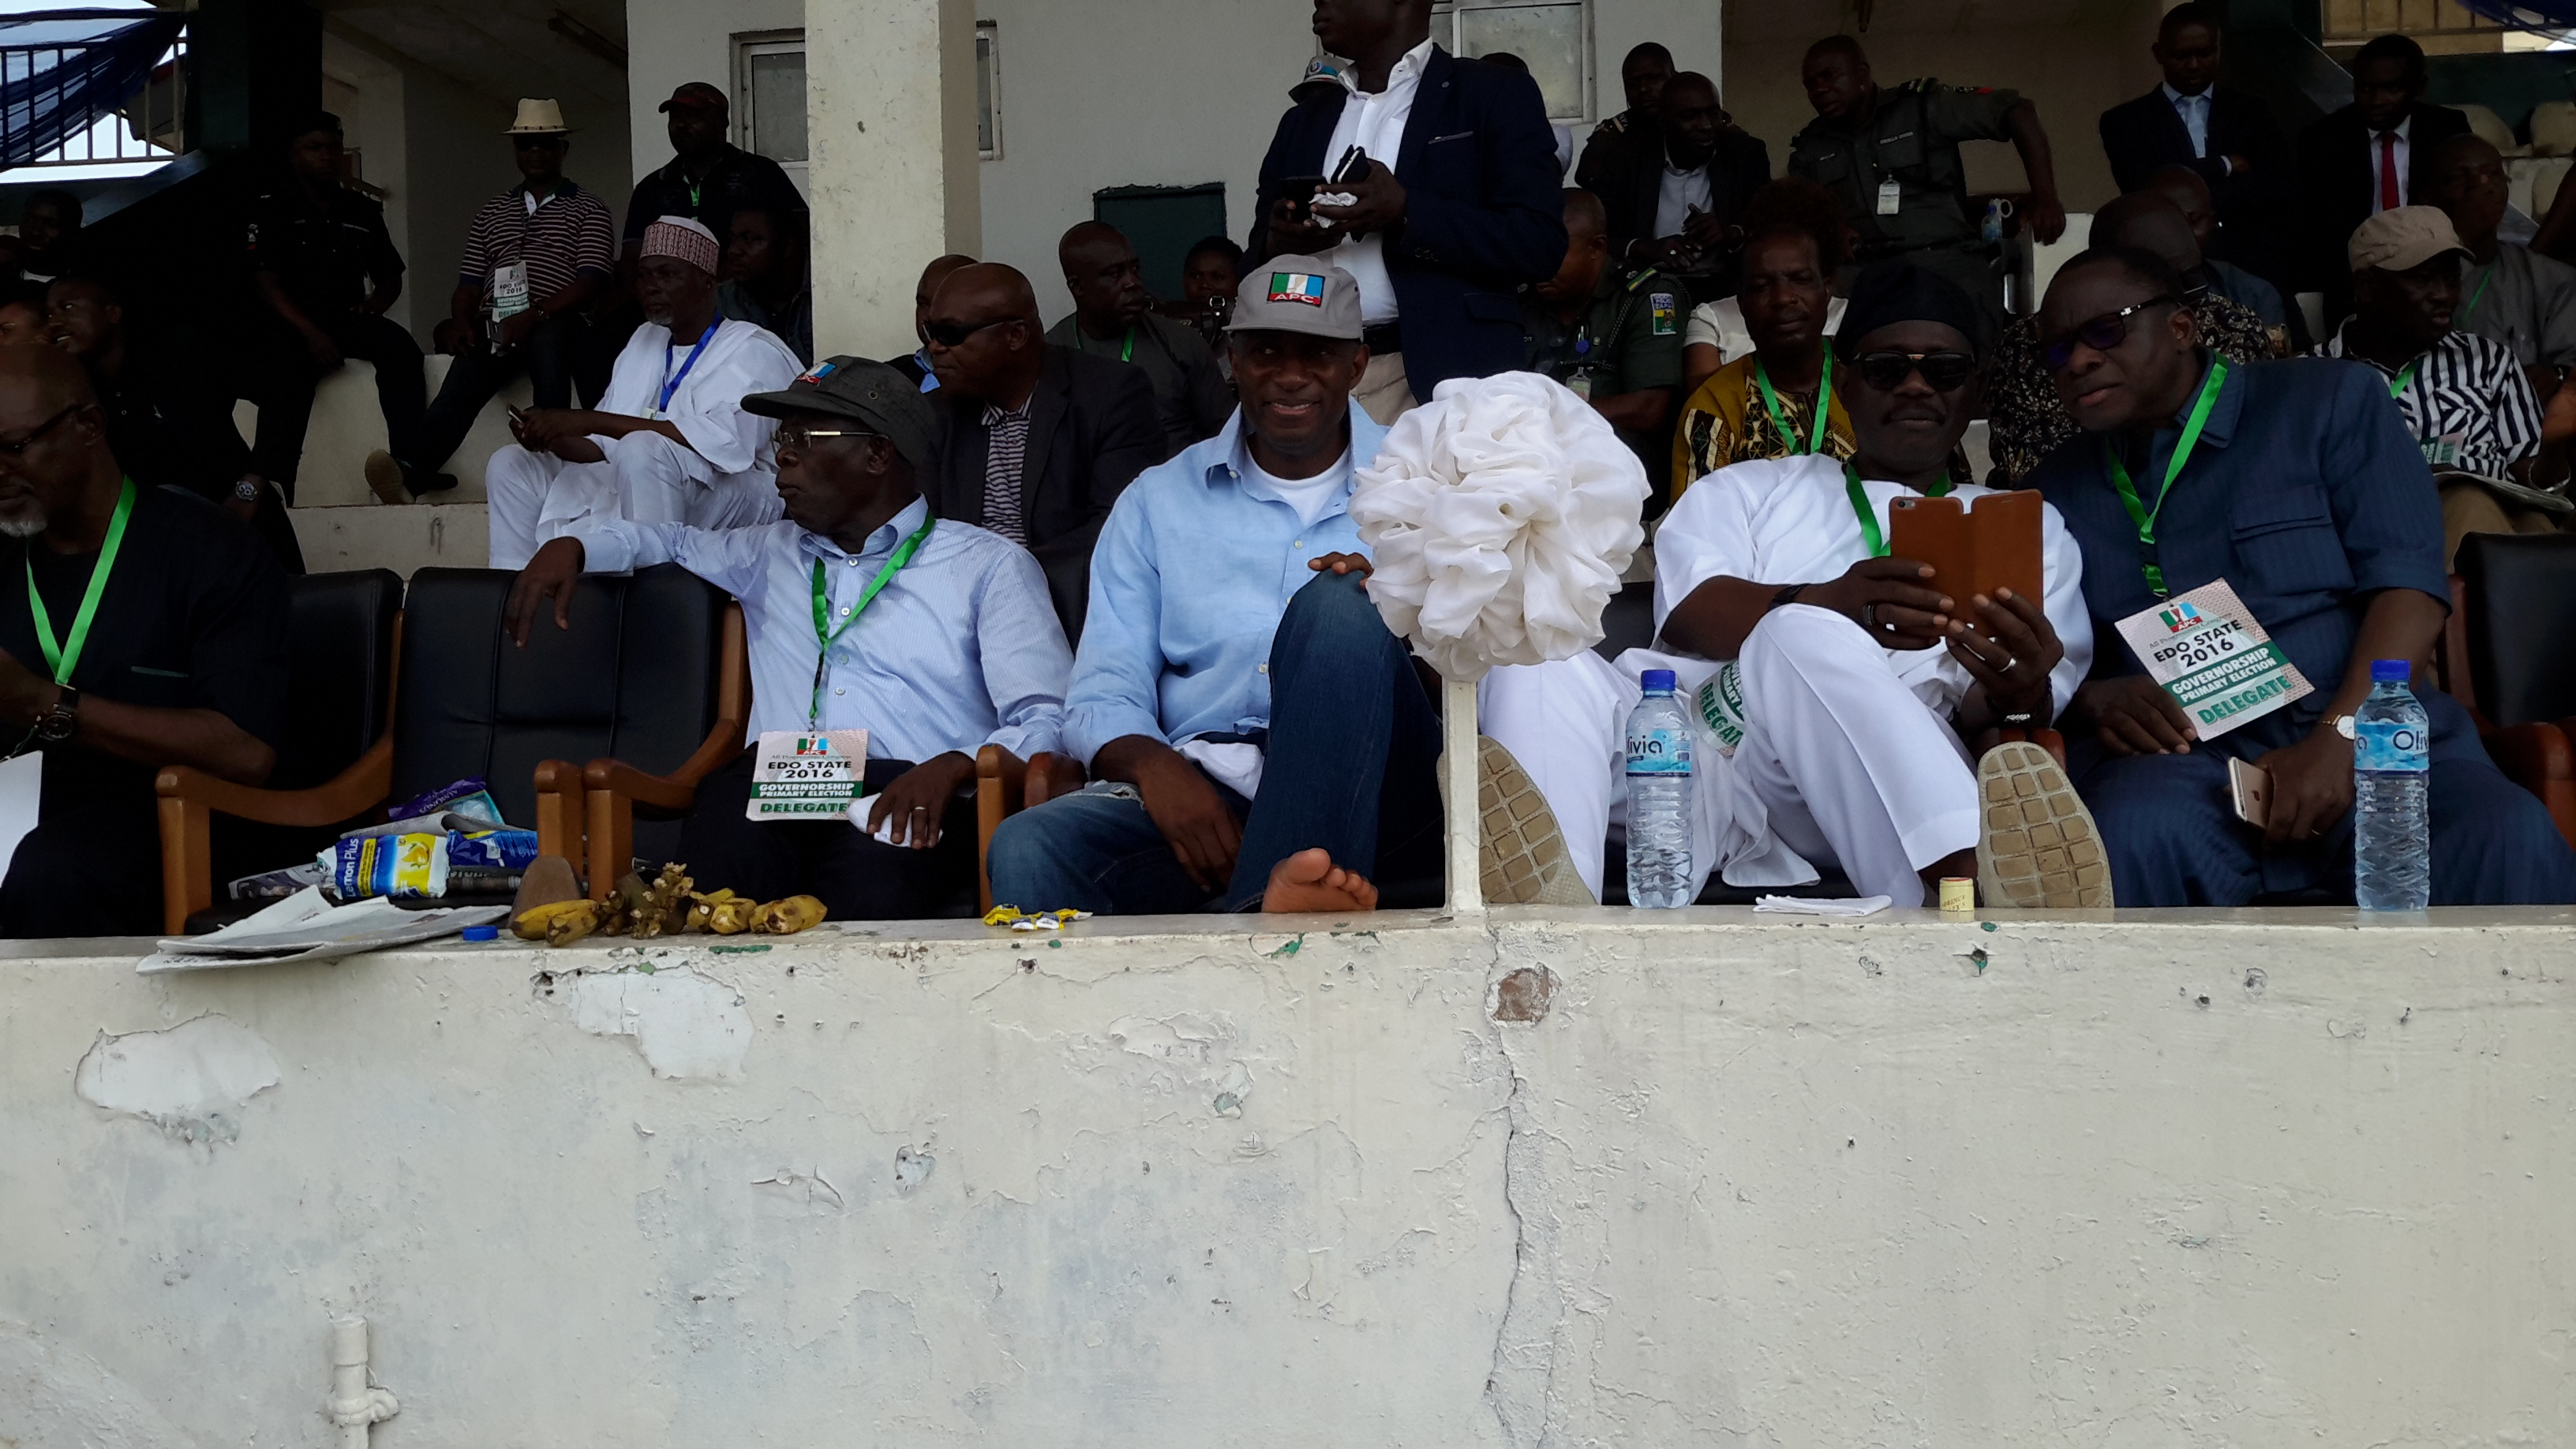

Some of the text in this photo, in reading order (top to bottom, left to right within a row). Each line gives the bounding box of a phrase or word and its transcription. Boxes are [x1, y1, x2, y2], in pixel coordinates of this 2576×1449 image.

[1274, 293, 1315, 304] APC
[2153, 620, 2244, 663] EDO STATE
[2177, 620, 2198, 631] APC
[2171, 647, 2271, 695] GOVERNORSHIP
[2180, 638, 2234, 668] 2016
[2181, 657, 2278, 703] PRIMARY ELECTION
[2197, 676, 2292, 724] DELEGATE
[784, 769, 834, 779] 2016
[760, 802, 848, 813] DELEGATE
[343, 837, 359, 898] Lemon Plus
